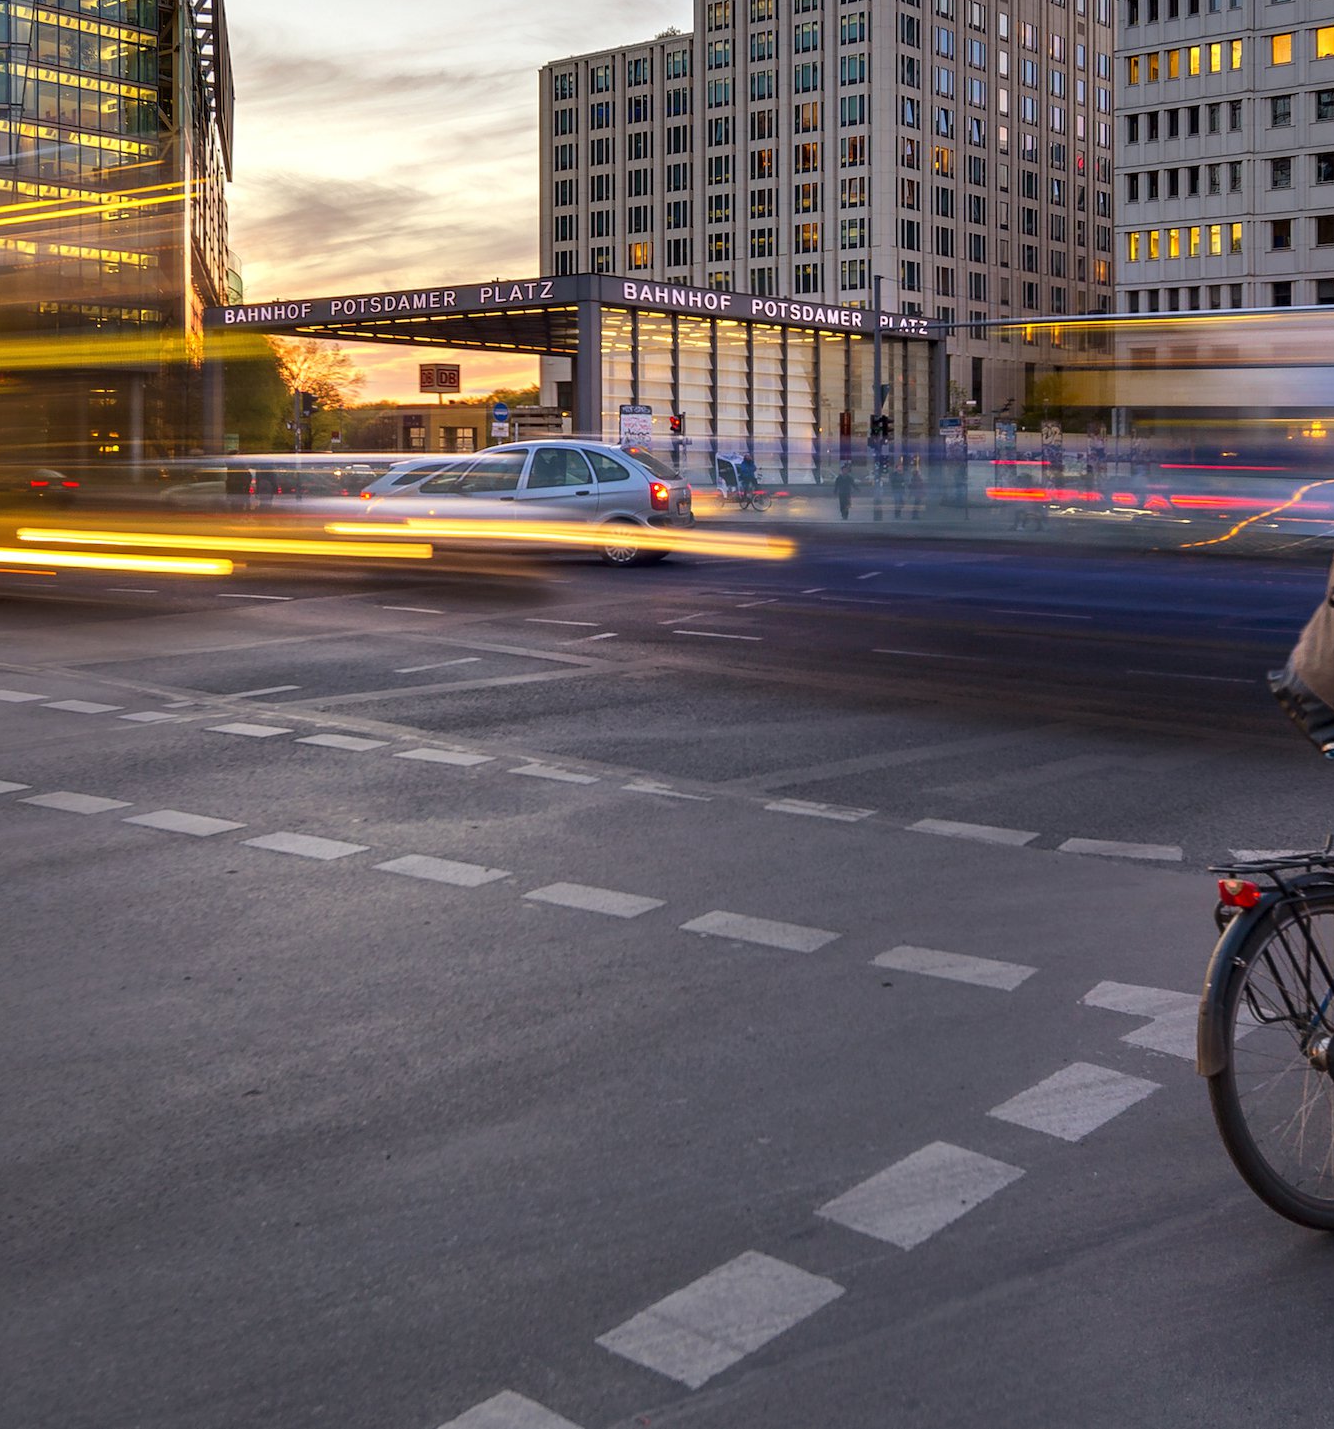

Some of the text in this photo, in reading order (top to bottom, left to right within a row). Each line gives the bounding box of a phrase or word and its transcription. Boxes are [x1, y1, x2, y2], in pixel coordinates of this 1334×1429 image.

[224, 281, 554, 324] BAHNHOF POTSDAMER PLATZ
[623, 282, 732, 311] BAHNHOF
[751, 299, 863, 328] POTSDAMER
[421, 371, 434, 385] DB
[439, 371, 457, 385] DB
